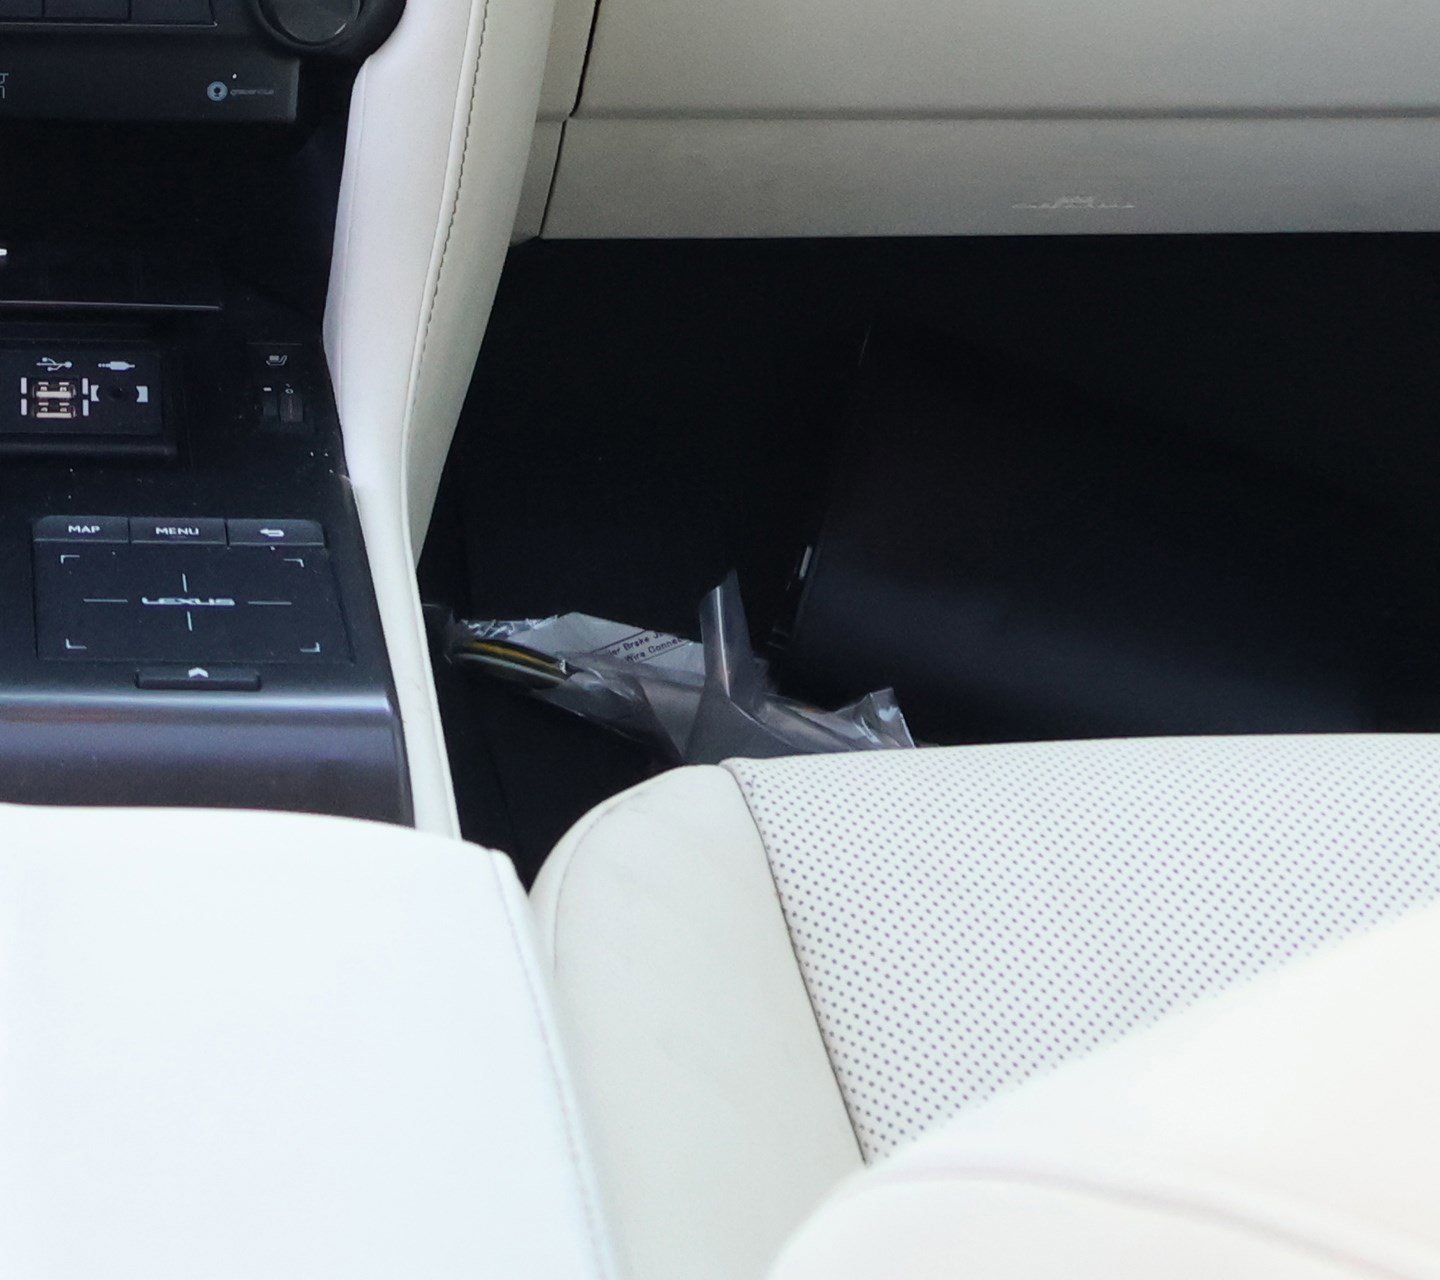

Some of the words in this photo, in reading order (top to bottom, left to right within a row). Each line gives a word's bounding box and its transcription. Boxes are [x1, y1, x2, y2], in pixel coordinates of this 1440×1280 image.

[68, 524, 101, 534] MAP
[155, 526, 200, 536] MENU
[141, 596, 236, 607] LEXUS
